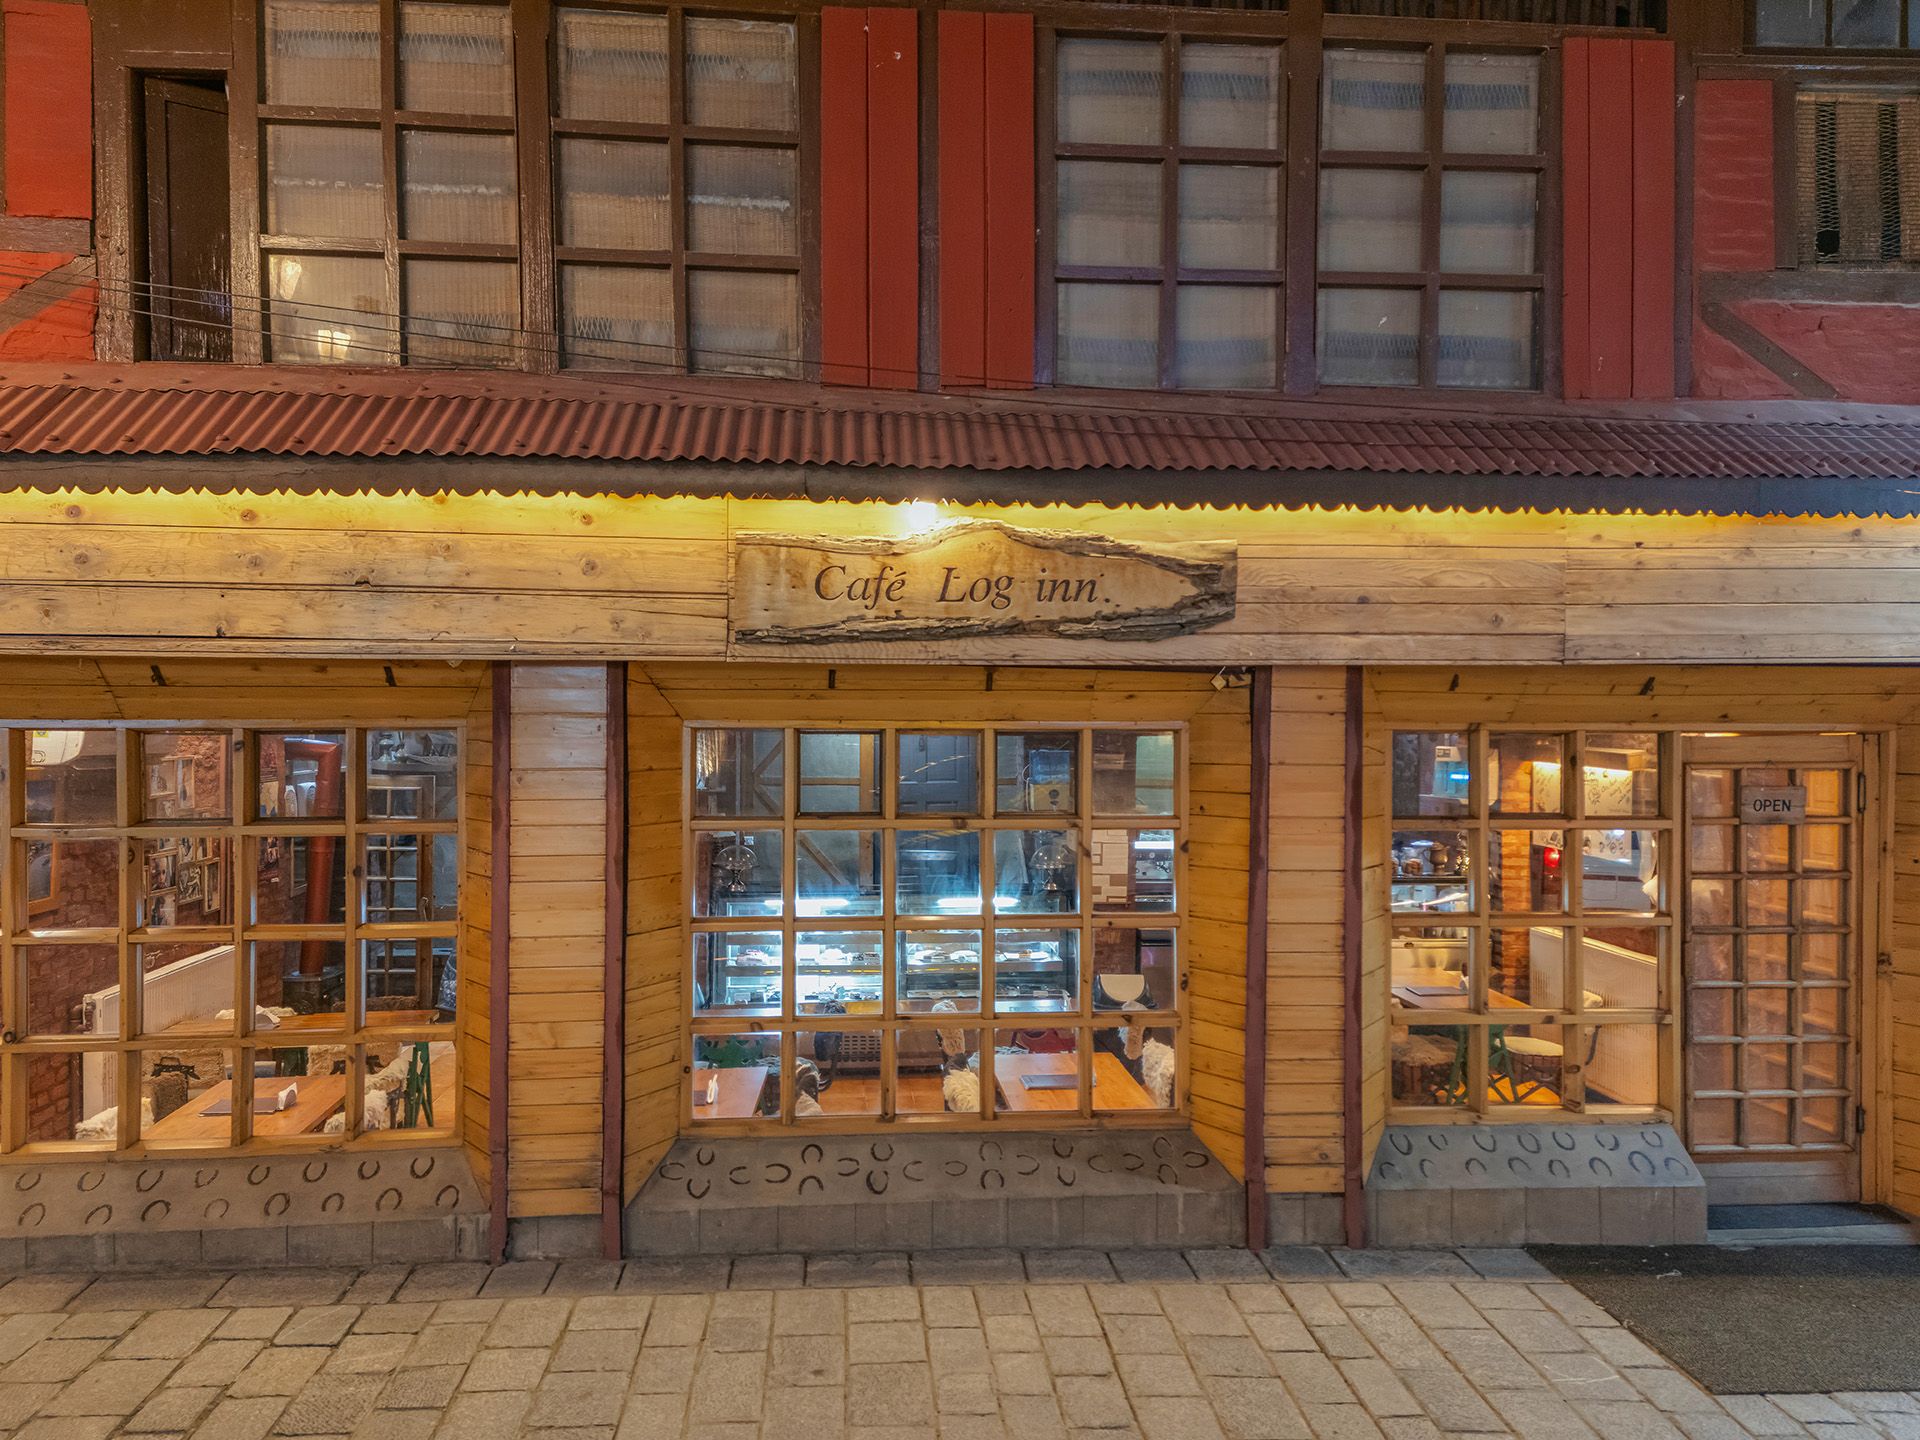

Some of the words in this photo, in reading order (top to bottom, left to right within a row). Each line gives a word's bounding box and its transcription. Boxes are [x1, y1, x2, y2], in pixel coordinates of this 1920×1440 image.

[815, 565, 907, 610] Café
[936, 567, 1015, 610] Log
[1753, 799, 1792, 812] OPEN
